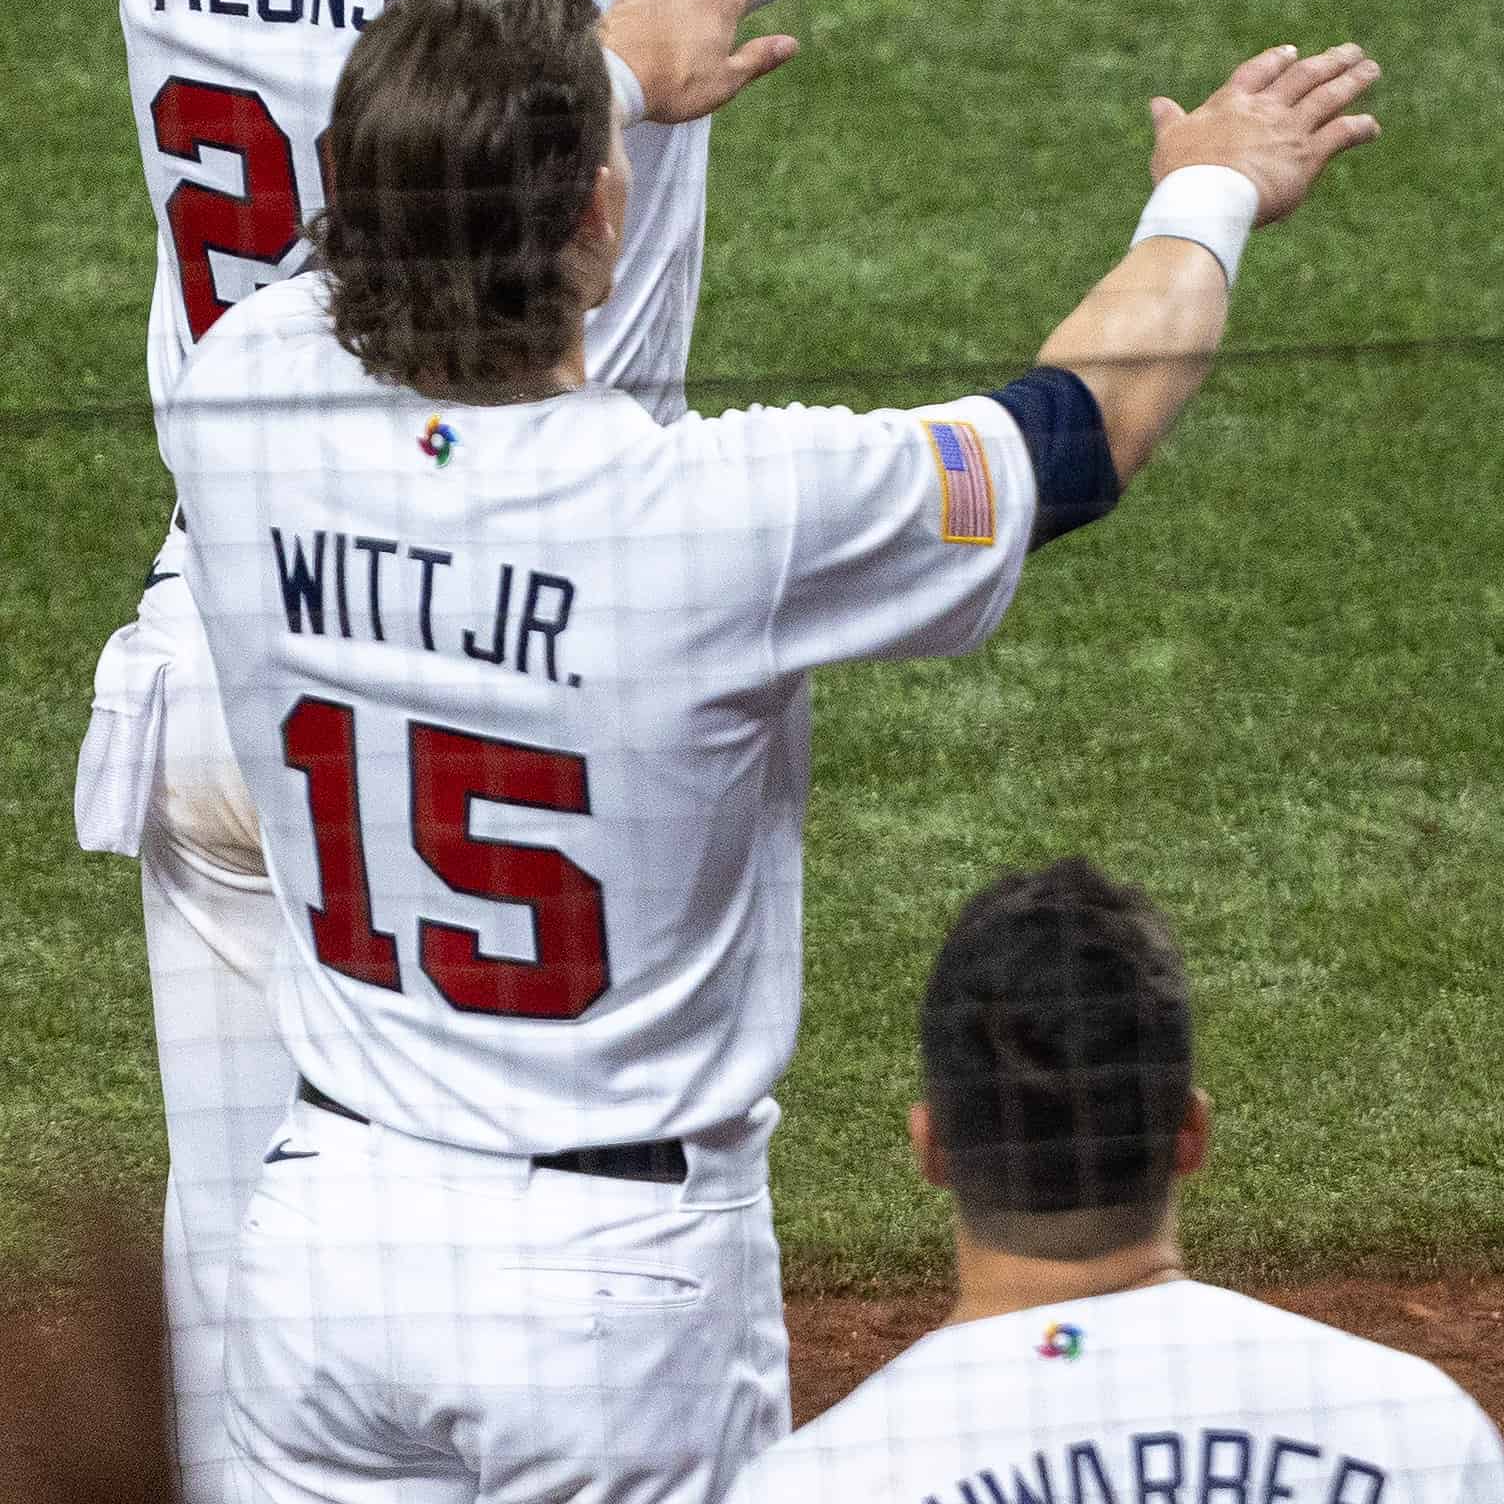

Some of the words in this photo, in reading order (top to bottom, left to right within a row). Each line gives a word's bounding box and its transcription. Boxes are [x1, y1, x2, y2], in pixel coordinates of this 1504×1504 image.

[149, 73, 339, 346] 2
[270, 526, 453, 652] WITT
[462, 562, 585, 688] JR.
[280, 693, 611, 1022] 15
